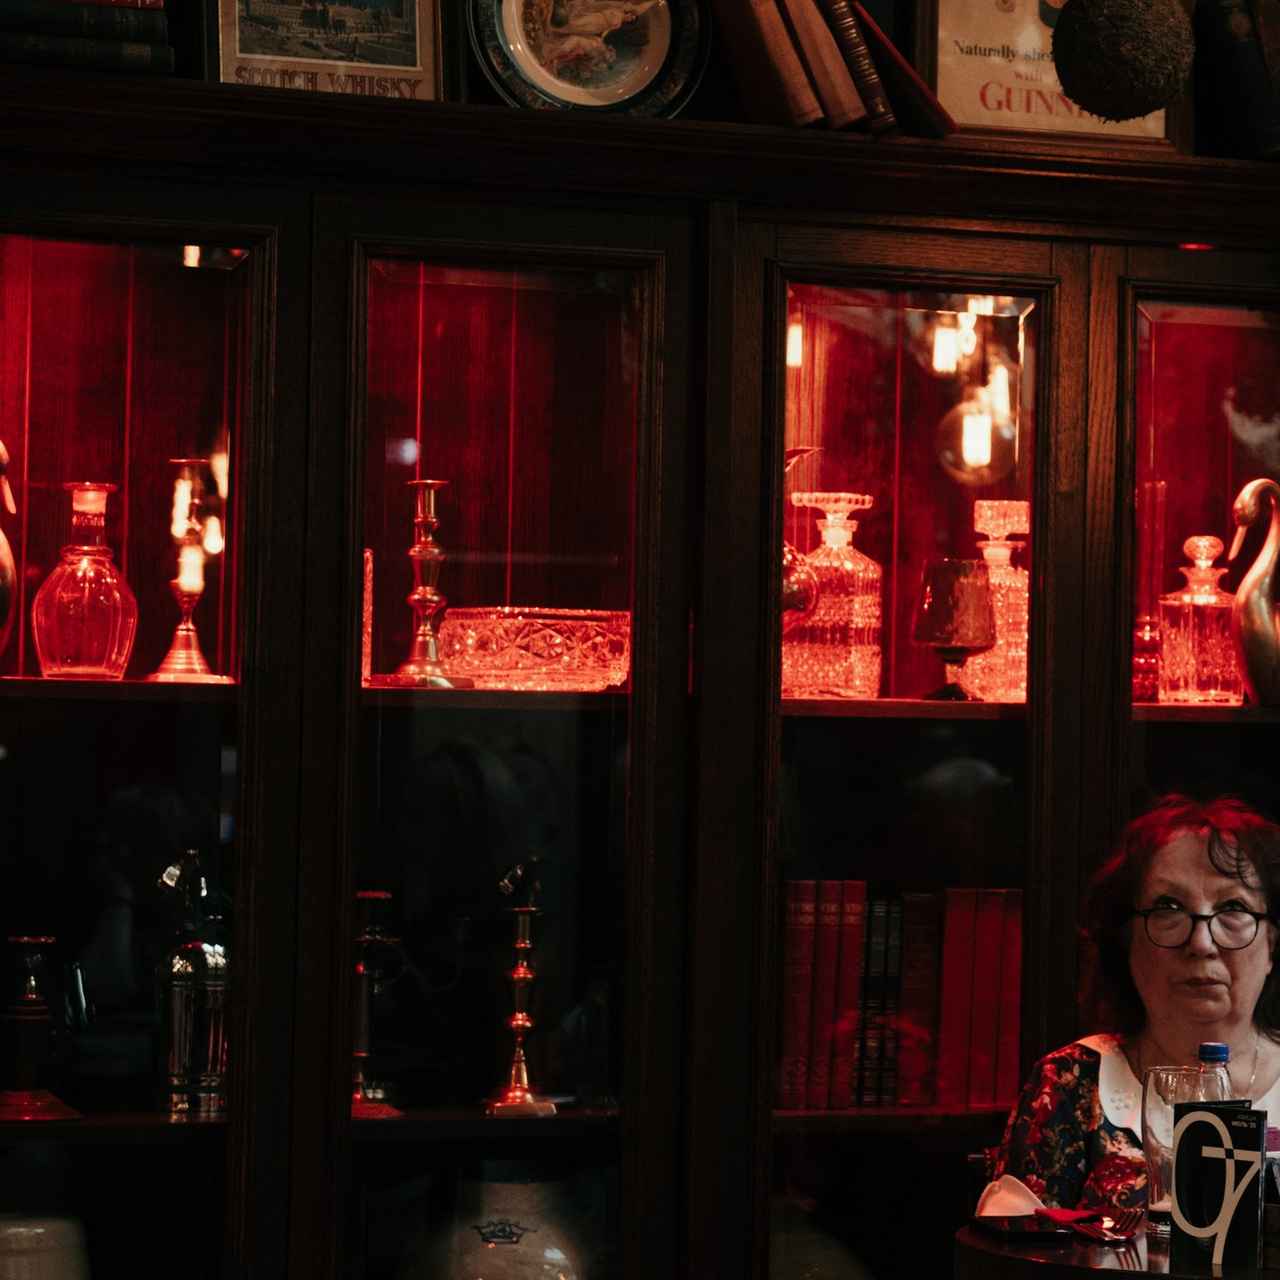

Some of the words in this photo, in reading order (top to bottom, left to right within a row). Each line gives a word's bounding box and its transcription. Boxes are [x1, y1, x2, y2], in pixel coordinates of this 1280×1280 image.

[953, 39, 1017, 63] Naturally
[235, 66, 319, 94] SCOTCH
[327, 71, 423, 100] WHISKY
